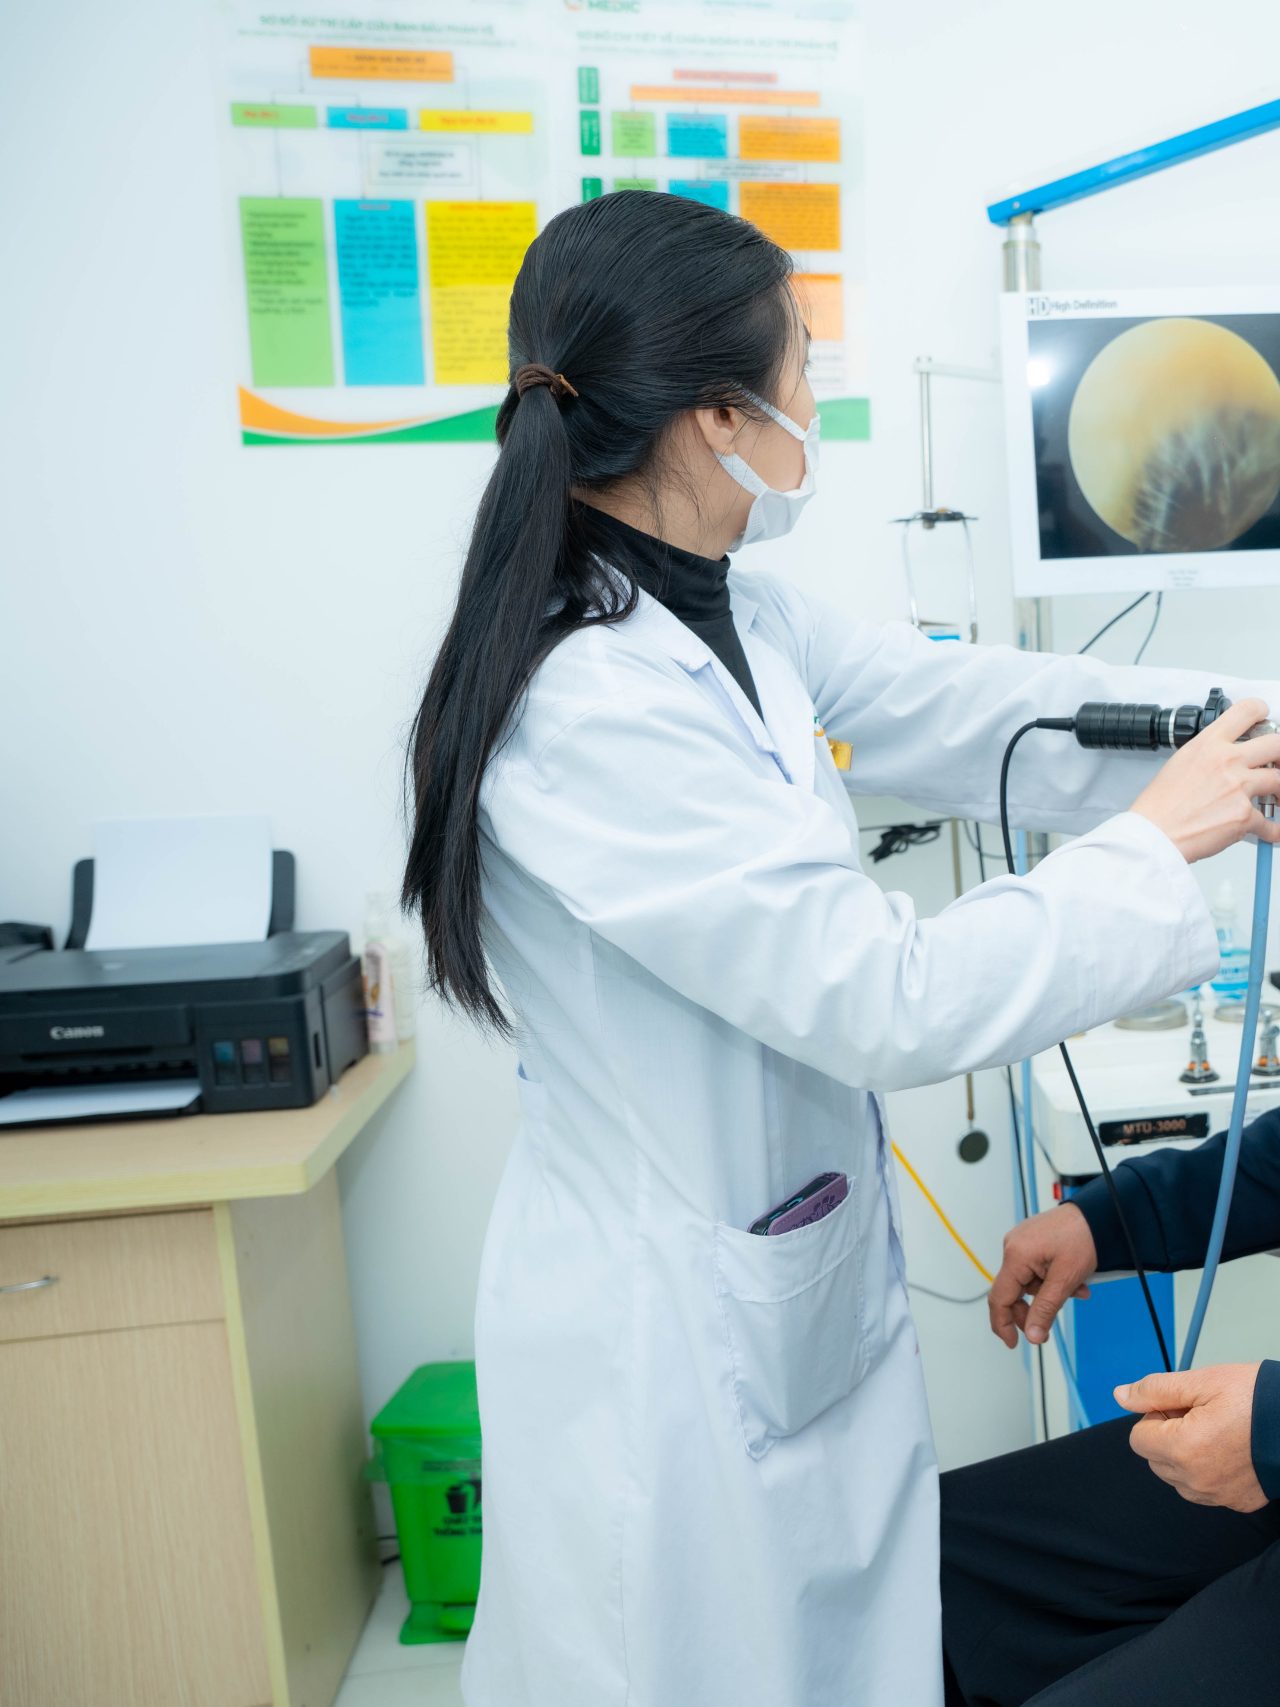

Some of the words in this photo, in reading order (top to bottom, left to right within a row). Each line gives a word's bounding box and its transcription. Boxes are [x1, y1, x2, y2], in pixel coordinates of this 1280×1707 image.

[1051, 300, 1070, 312] High
[1073, 299, 1118, 310] Definition
[50, 1025, 105, 1040] Canon
[1123, 1118, 1187, 1135] MTU-3000
